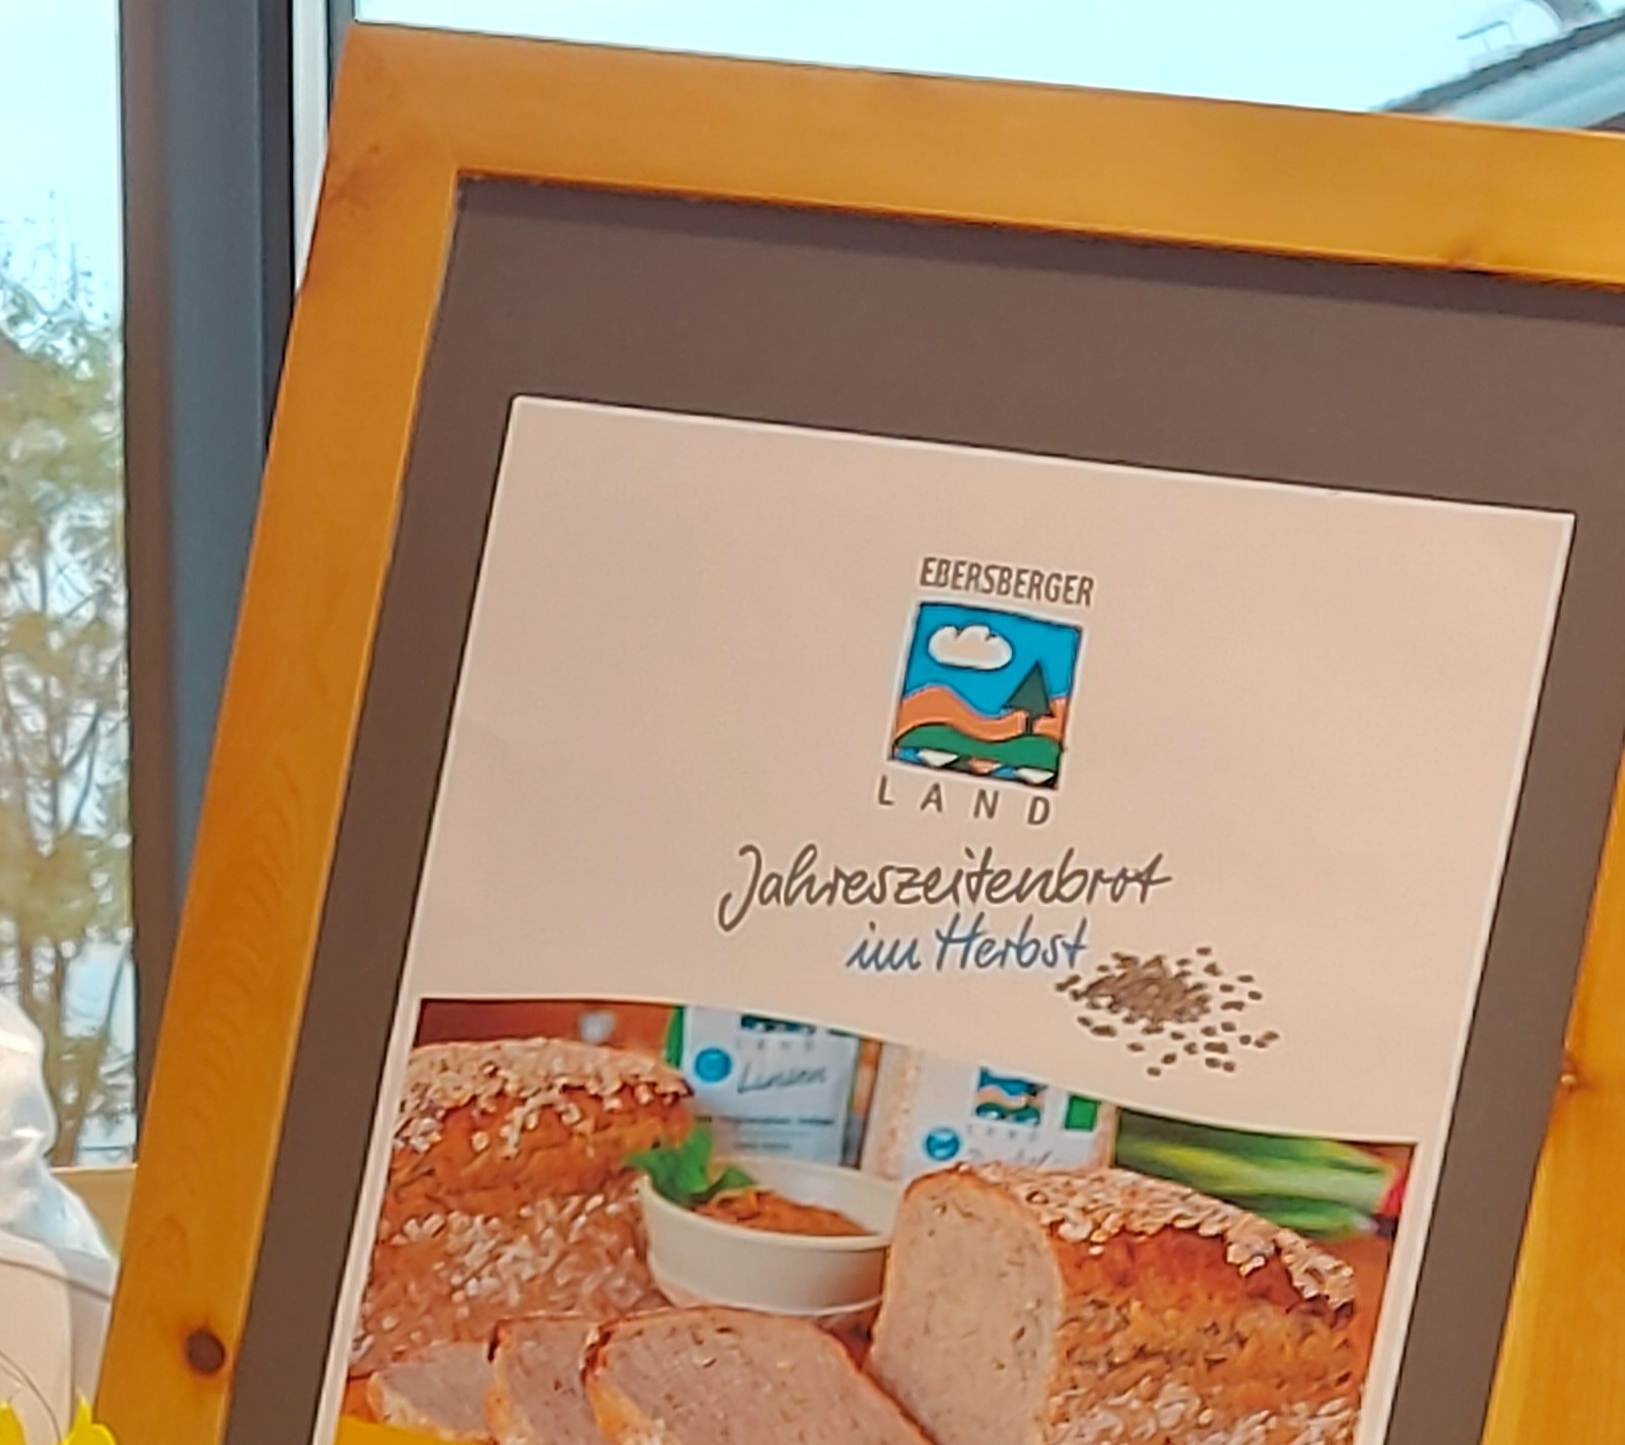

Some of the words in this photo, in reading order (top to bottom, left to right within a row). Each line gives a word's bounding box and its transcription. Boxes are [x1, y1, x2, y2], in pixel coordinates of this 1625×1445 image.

[919, 556, 1095, 607] EBERSBERGER
[876, 775, 1052, 827] LAND
[718, 844, 1173, 932] Jahreszeitenbrot
[845, 922, 922, 972] im
[934, 911, 1089, 974] Herbst
